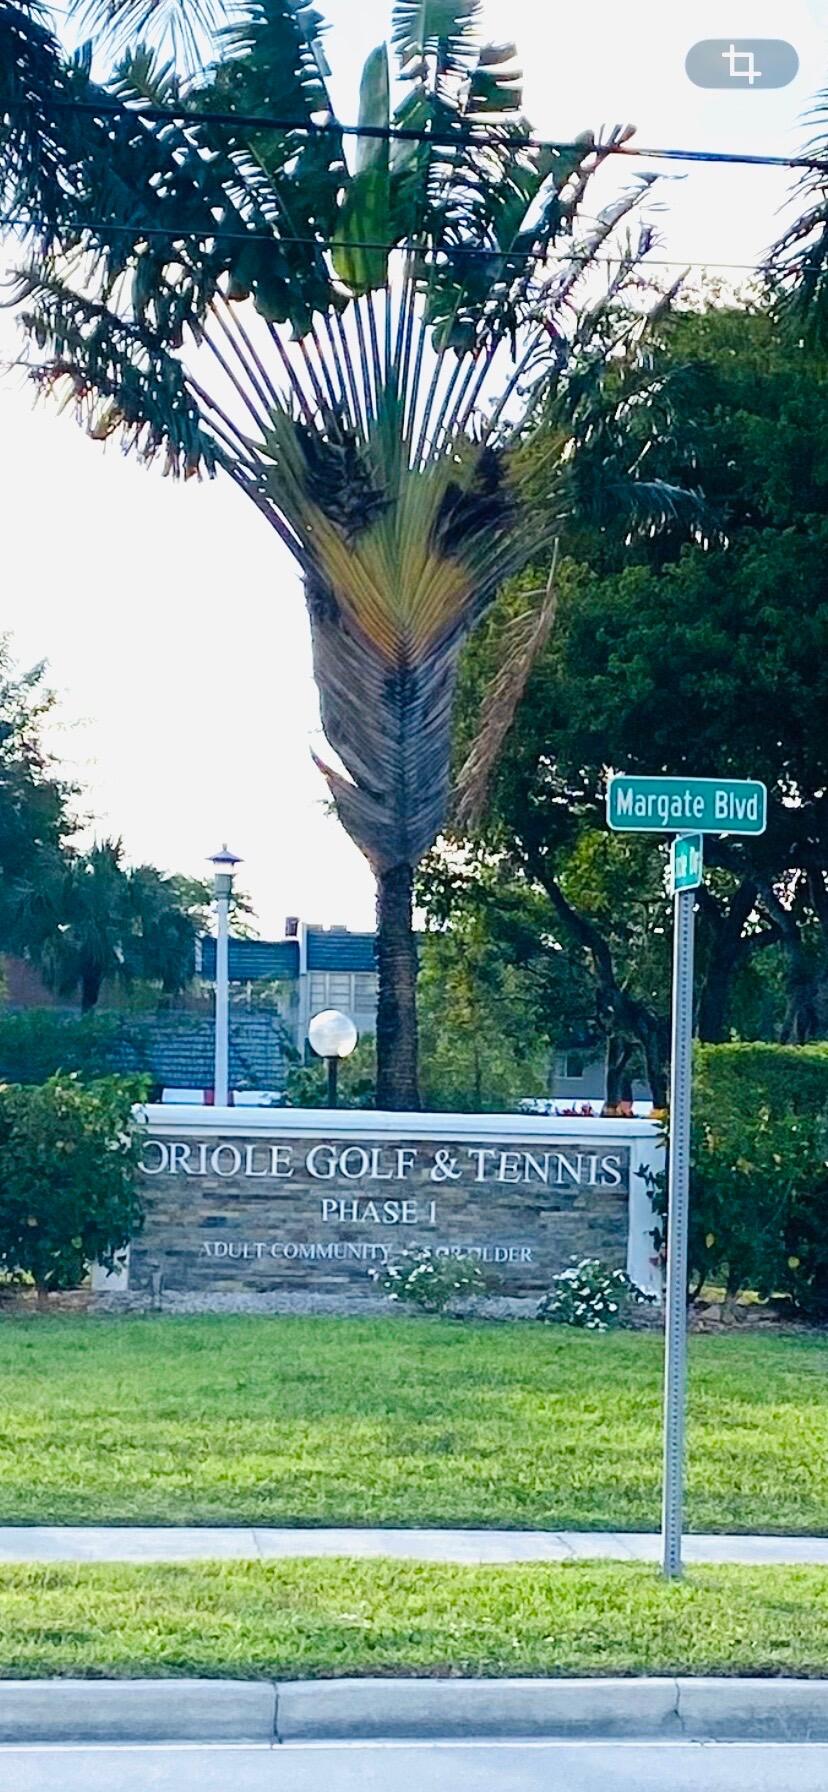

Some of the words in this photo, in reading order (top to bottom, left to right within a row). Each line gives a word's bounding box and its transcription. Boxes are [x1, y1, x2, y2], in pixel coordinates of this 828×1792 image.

[616, 787, 704, 826] Margate
[714, 790, 758, 821] Blvd
[138, 1140, 295, 1178] ORIOLE
[306, 1144, 417, 1180] GOLF
[430, 1148, 463, 1182] &
[467, 1148, 623, 1187] TENNIS
[321, 1198, 418, 1225] PHASE
[201, 1241, 266, 1259] ADULT
[271, 1243, 393, 1264] COMMUNITY
